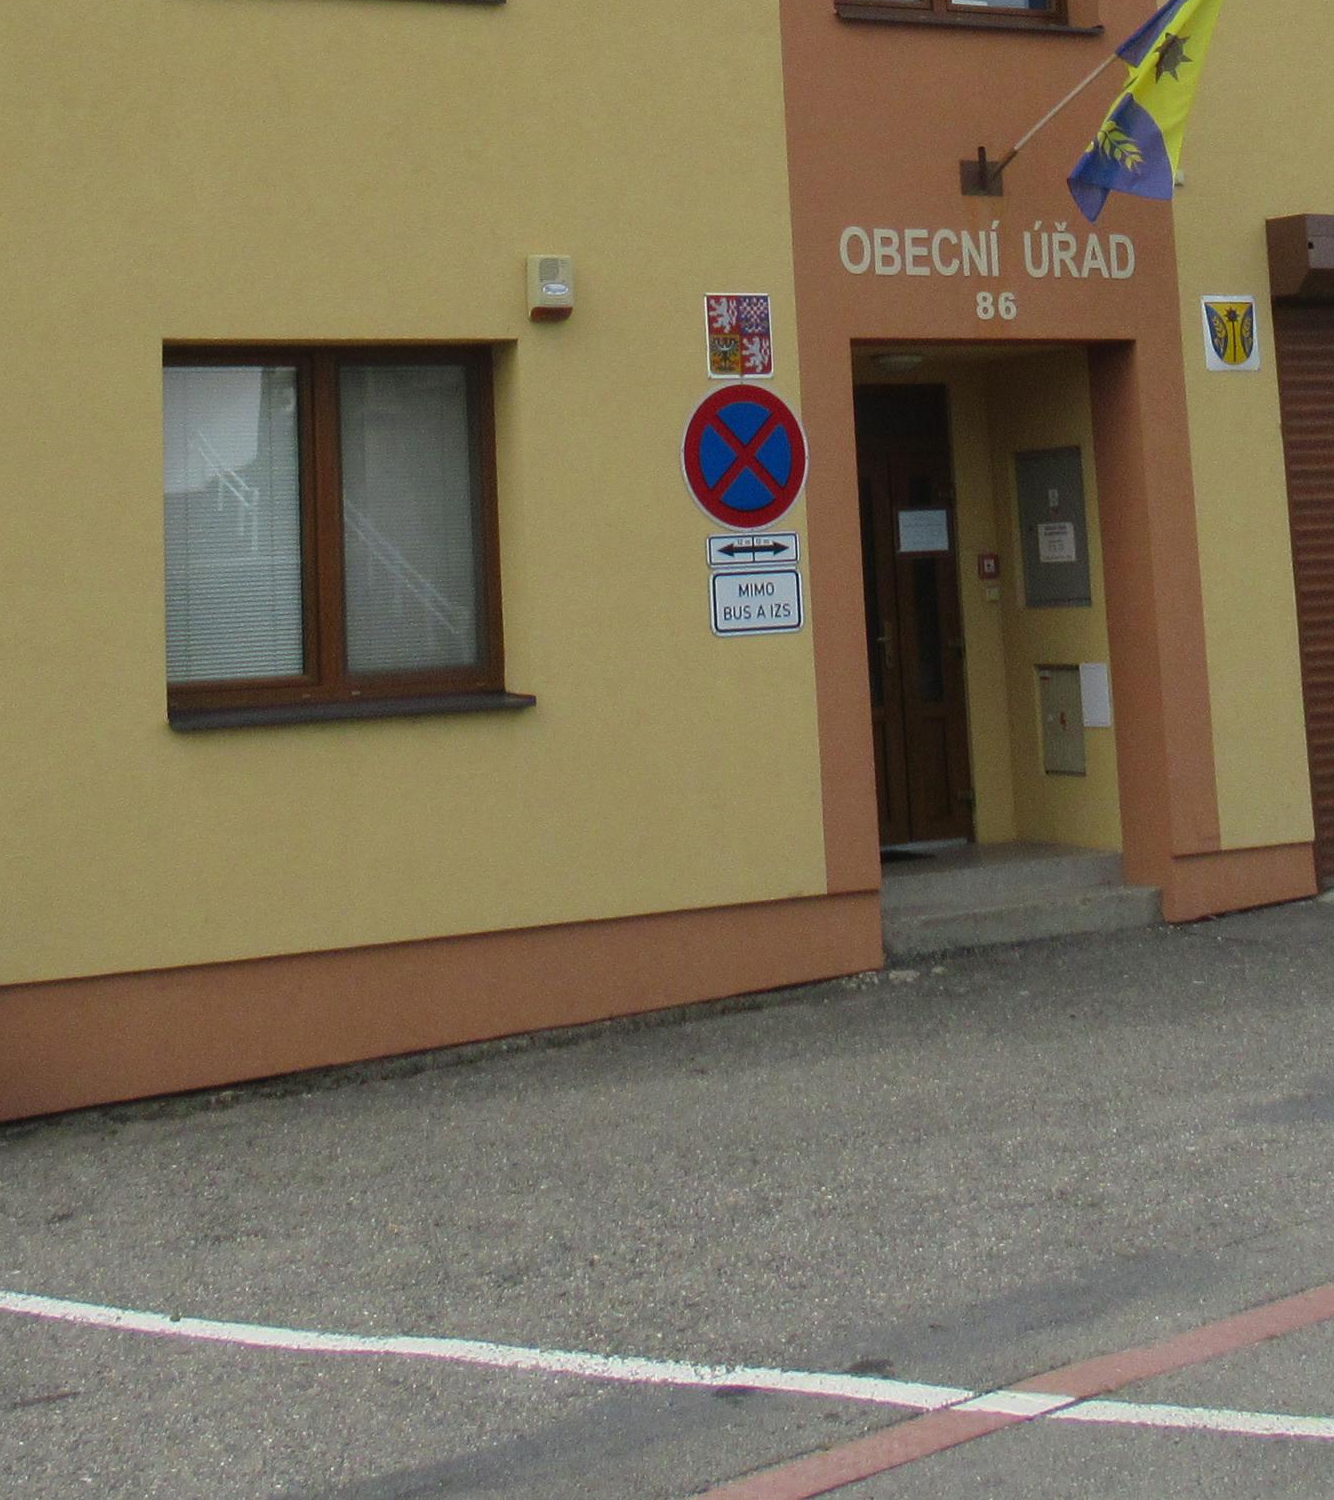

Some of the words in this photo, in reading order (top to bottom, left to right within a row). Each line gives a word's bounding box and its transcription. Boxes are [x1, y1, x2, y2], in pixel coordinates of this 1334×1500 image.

[839, 220, 1000, 277] OBECNÍ
[1024, 220, 1136, 279] ÚŘAD
[976, 292, 1017, 319] 86
[738, 582, 775, 597] MIMO
[723, 606, 752, 621] BUS
[756, 605, 766, 618] A
[770, 603, 791, 619] IZS
